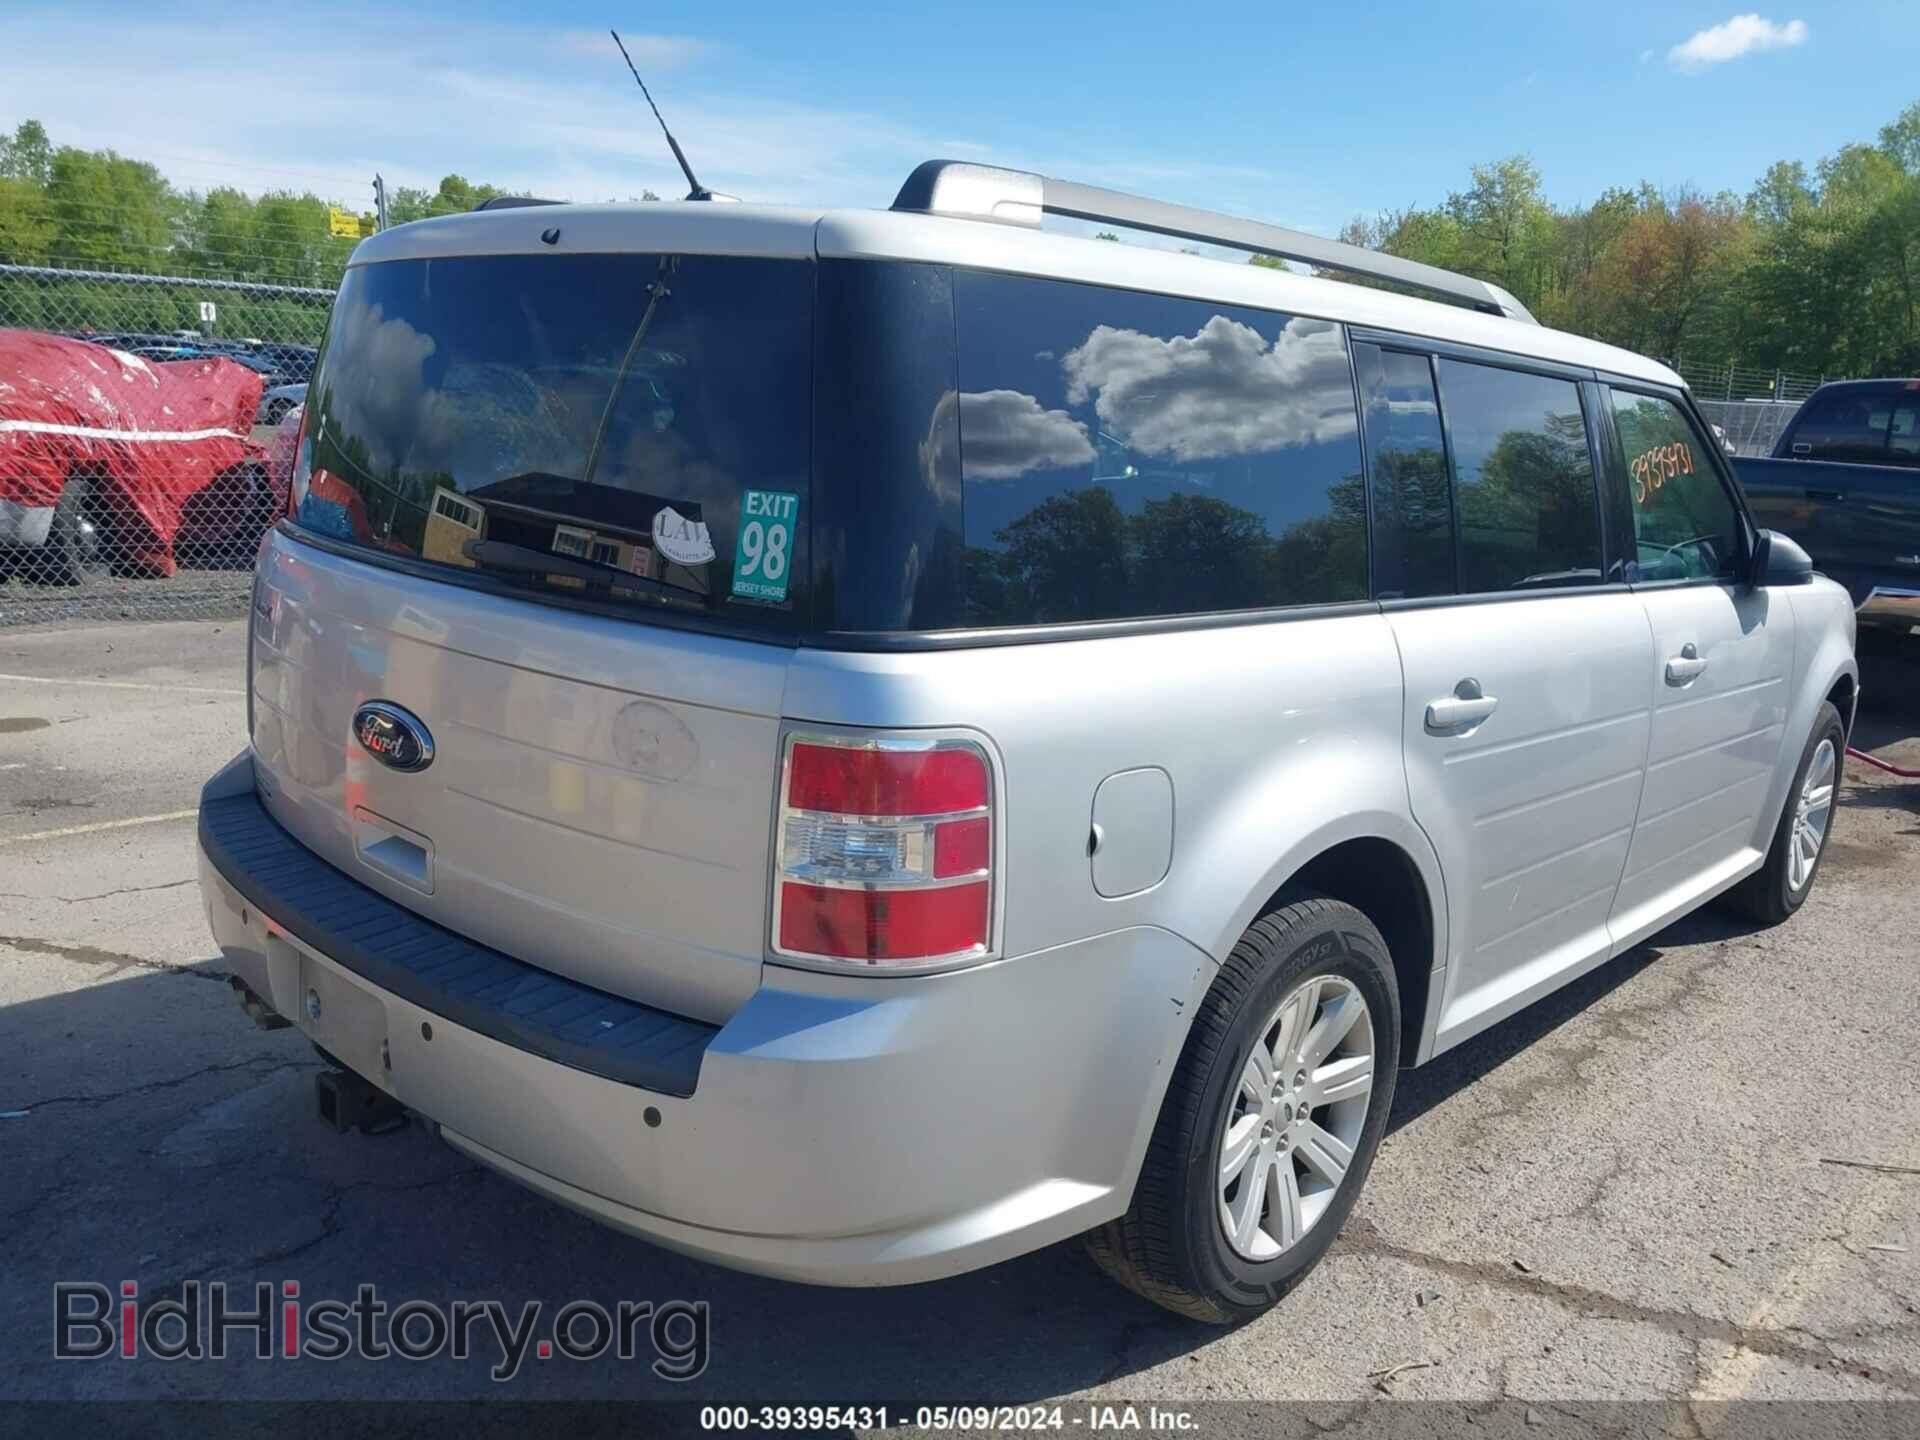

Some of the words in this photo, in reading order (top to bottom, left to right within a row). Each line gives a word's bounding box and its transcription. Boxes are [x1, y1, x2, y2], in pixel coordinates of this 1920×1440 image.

[746, 492, 796, 518] EXIT
[741, 521, 788, 580] 98
[734, 582, 760, 593] JERSEY
[760, 585, 786, 598] SHORE
[361, 714, 405, 758] Ford
